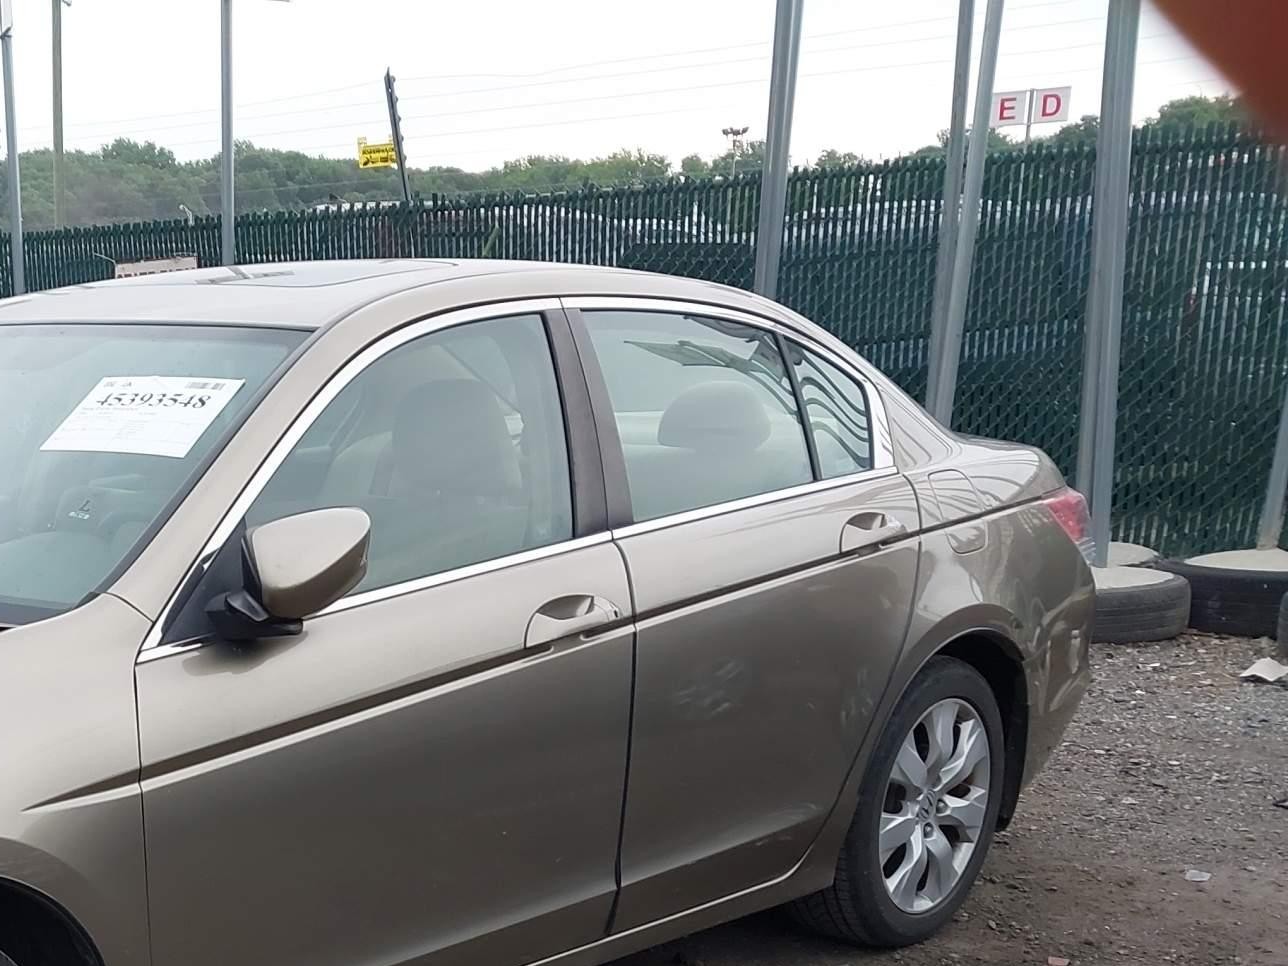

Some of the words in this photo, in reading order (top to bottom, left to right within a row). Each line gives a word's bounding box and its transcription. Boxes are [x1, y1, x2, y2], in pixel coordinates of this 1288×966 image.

[999, 97, 1016, 121] E
[1041, 93, 1062, 117] D
[96, 392, 211, 409] 45393548
